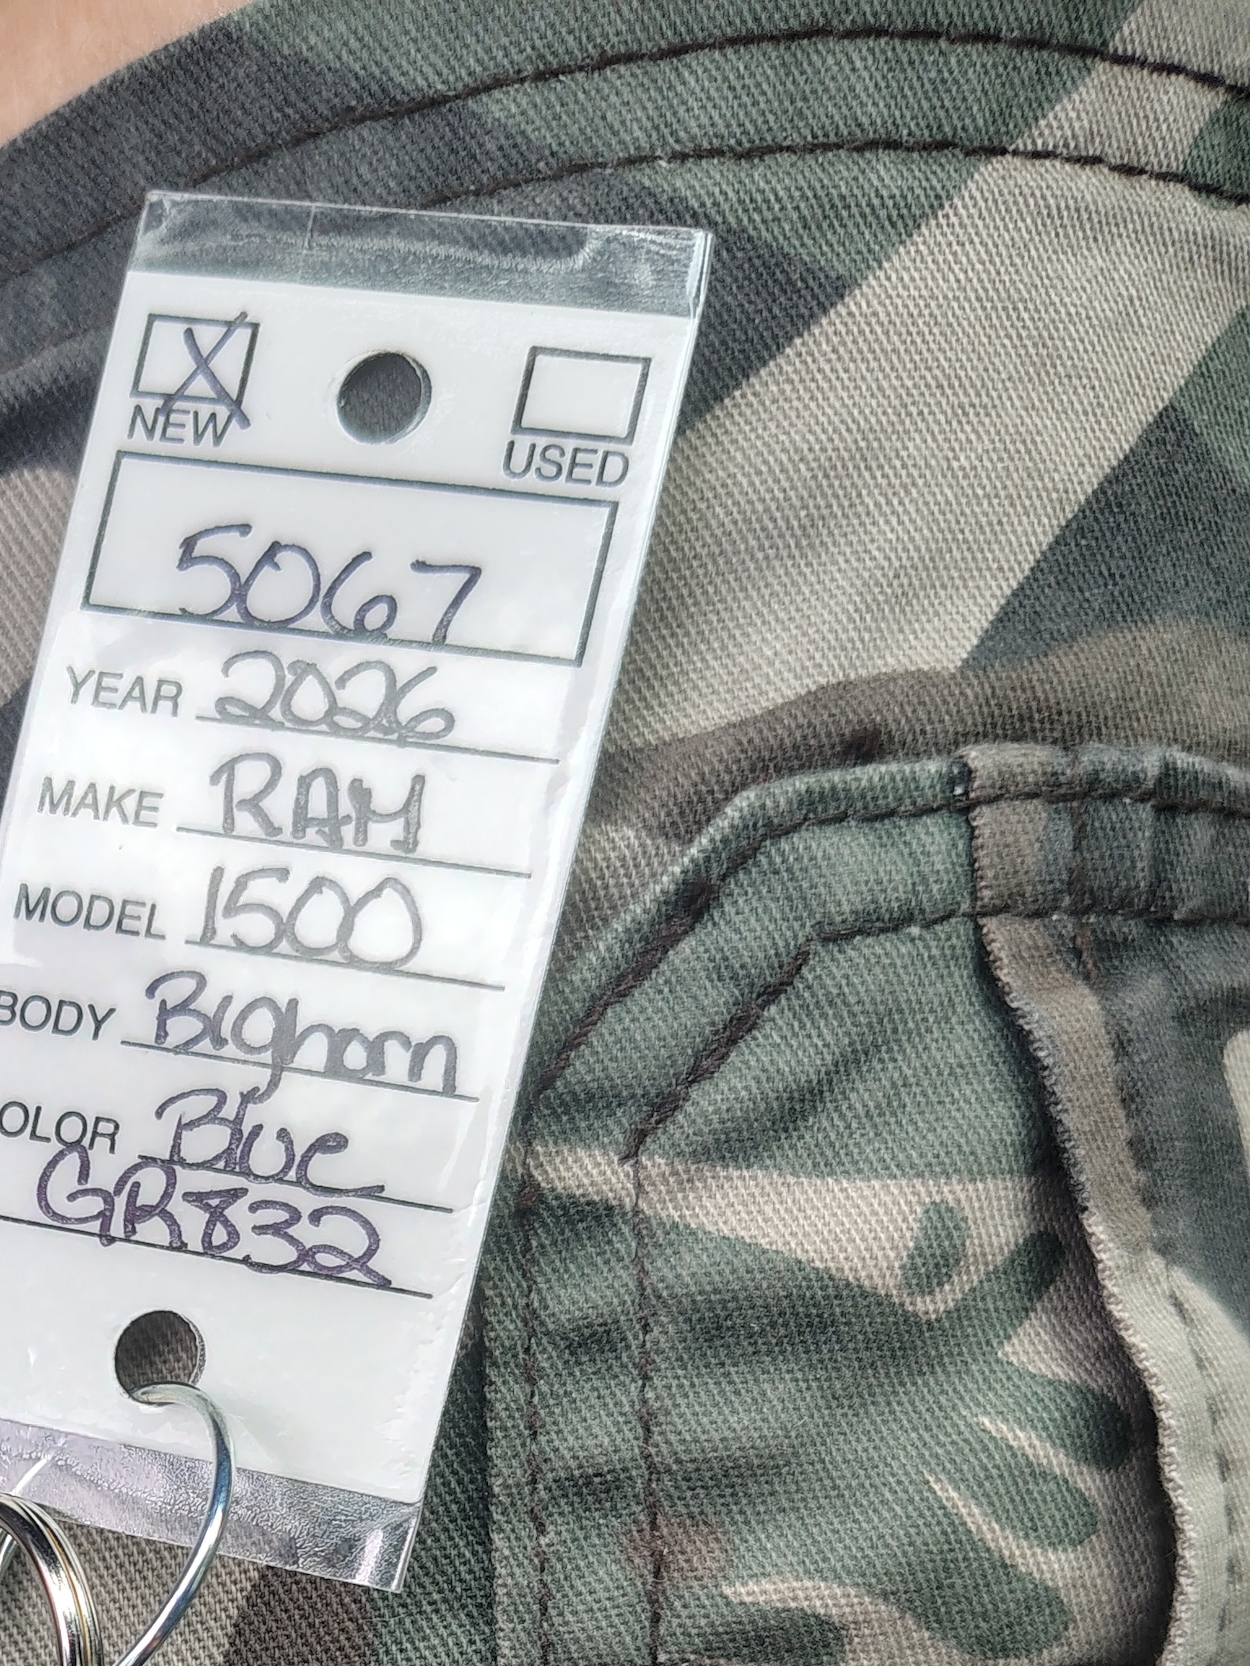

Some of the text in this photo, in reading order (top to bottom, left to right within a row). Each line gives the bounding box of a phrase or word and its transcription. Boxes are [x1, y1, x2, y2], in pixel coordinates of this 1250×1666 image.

[127, 403, 234, 448] NEW
[503, 440, 629, 488] USED
[176, 523, 482, 645] 5067
[66, 665, 183, 718] YEAR
[214, 650, 456, 744] 2026
[36, 776, 164, 828] MAKE
[210, 751, 425, 853] RAM
[12, 883, 167, 940] MODEL
[200, 865, 423, 971] 1500
[155, 1086, 385, 1197] Blue
